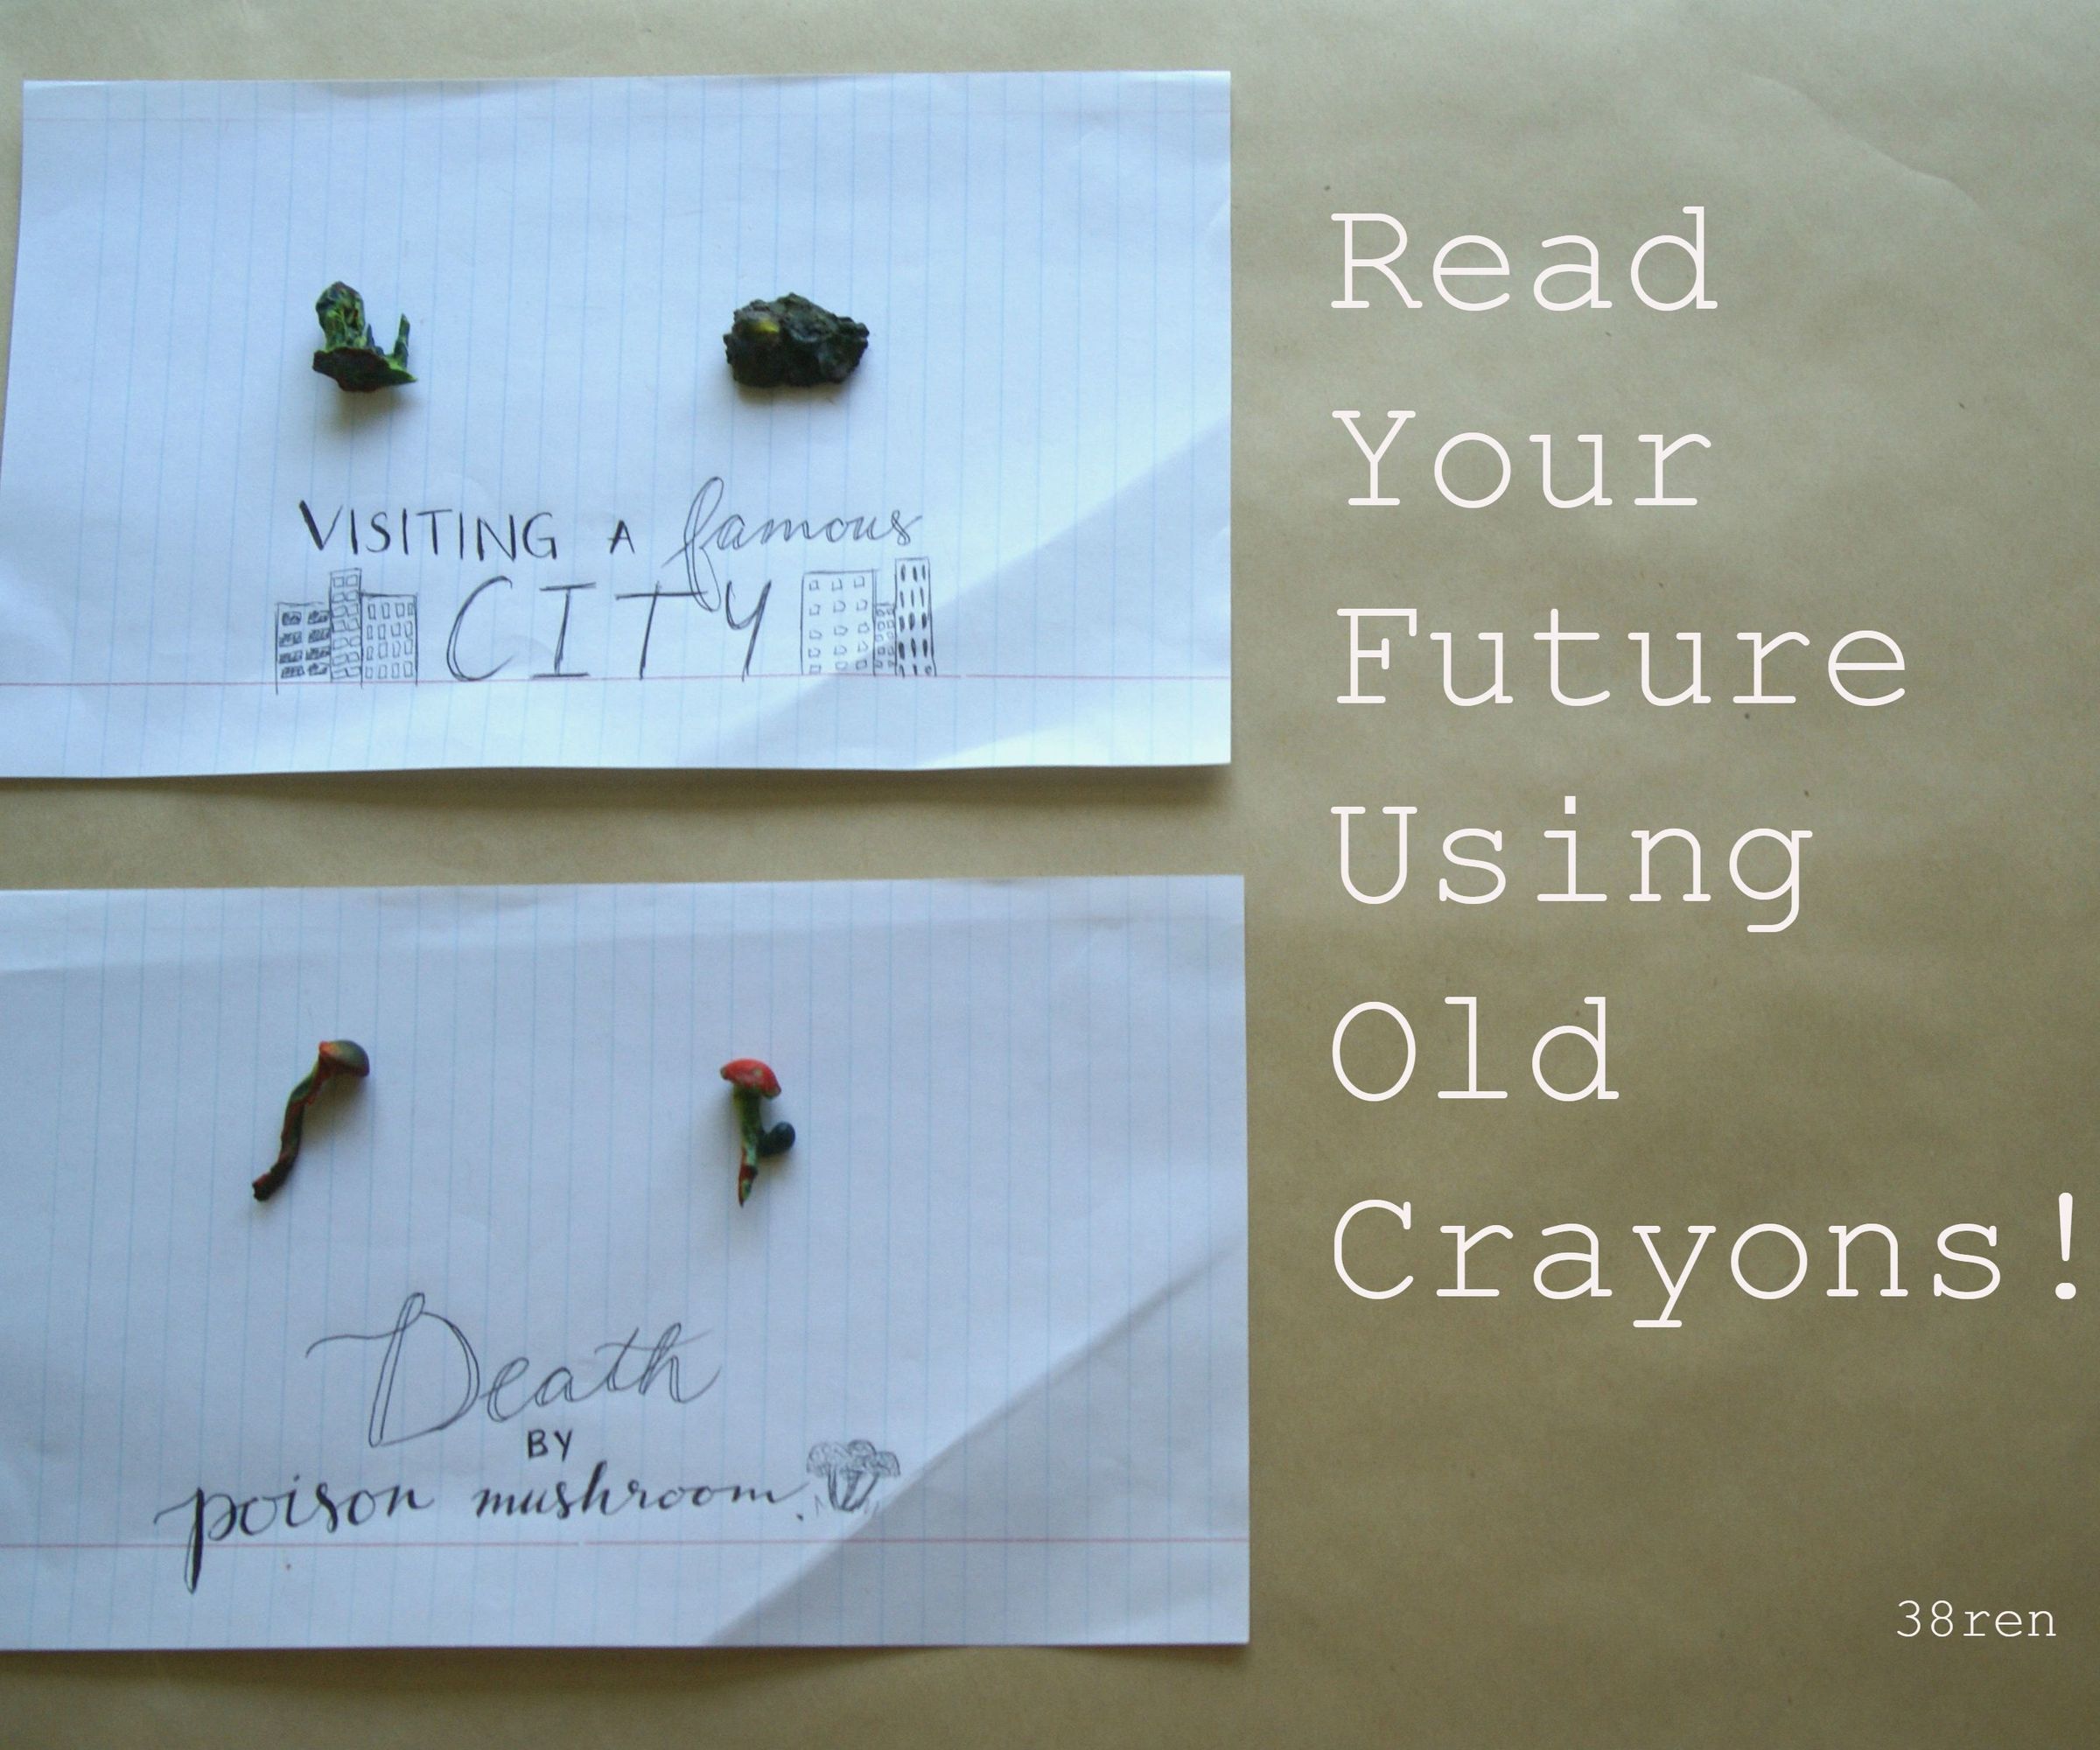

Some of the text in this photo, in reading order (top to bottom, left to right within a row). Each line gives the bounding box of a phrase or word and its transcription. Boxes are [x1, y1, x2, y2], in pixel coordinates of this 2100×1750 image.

[299, 476, 923, 612] VISITING A famous
[445, 575, 772, 682] CITY
[305, 1292, 722, 1448] Death
[527, 1428, 574, 1460] BY
[154, 1474, 436, 1595] poison
